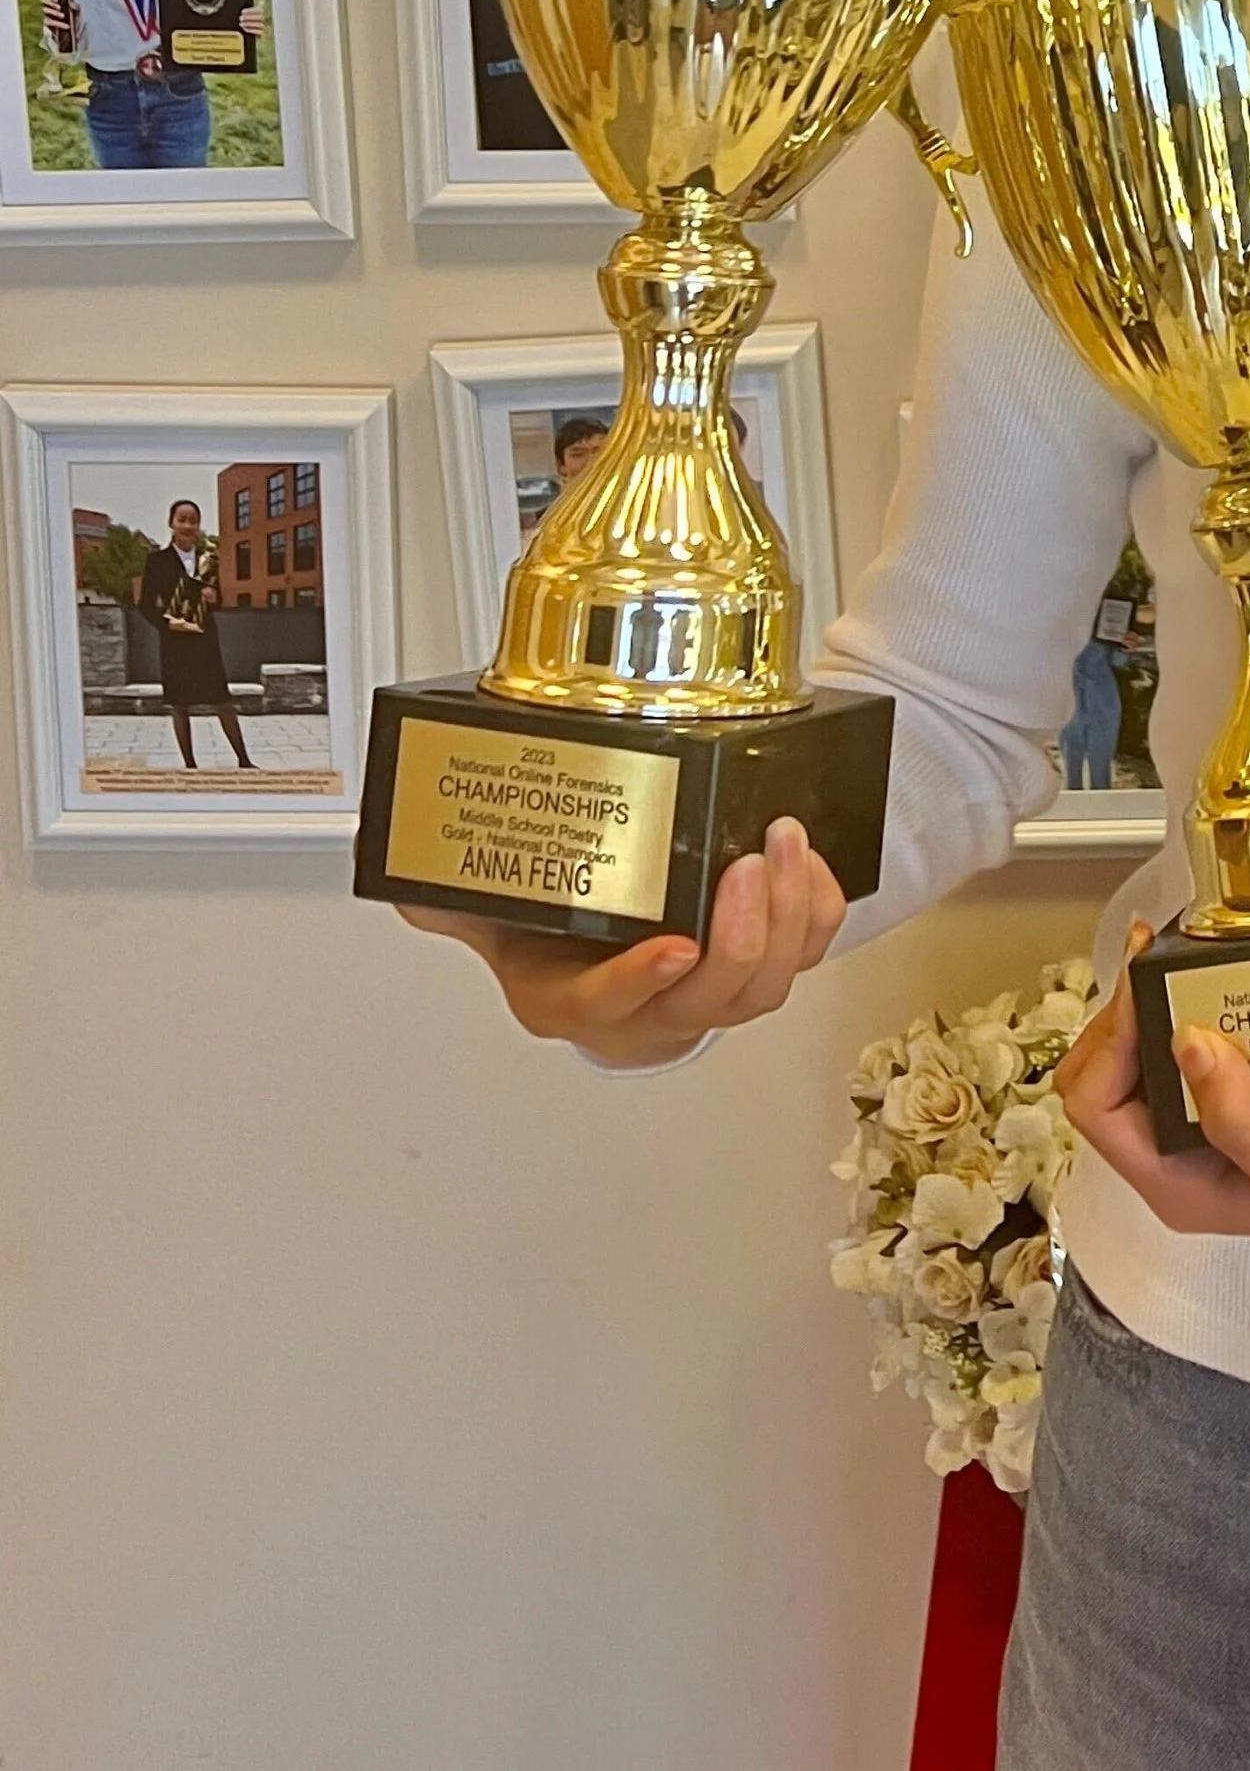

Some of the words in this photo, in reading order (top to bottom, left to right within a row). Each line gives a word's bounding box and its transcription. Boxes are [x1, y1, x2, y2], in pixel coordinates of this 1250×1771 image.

[449, 756, 505, 778] National
[509, 765, 553, 785] Online
[557, 772, 624, 797] Forensics
[520, 747, 556, 766] 2023
[438, 775, 629, 825] CHAMPIONSHIPS
[441, 824, 474, 843] Gold
[487, 831, 542, 854] National
[546, 840, 616, 866] Champion
[459, 807, 504, 829] Middle
[508, 815, 555, 837] School
[558, 823, 604, 848] Poetry
[459, 846, 522, 886] ANNA
[528, 857, 593, 896] FENG
